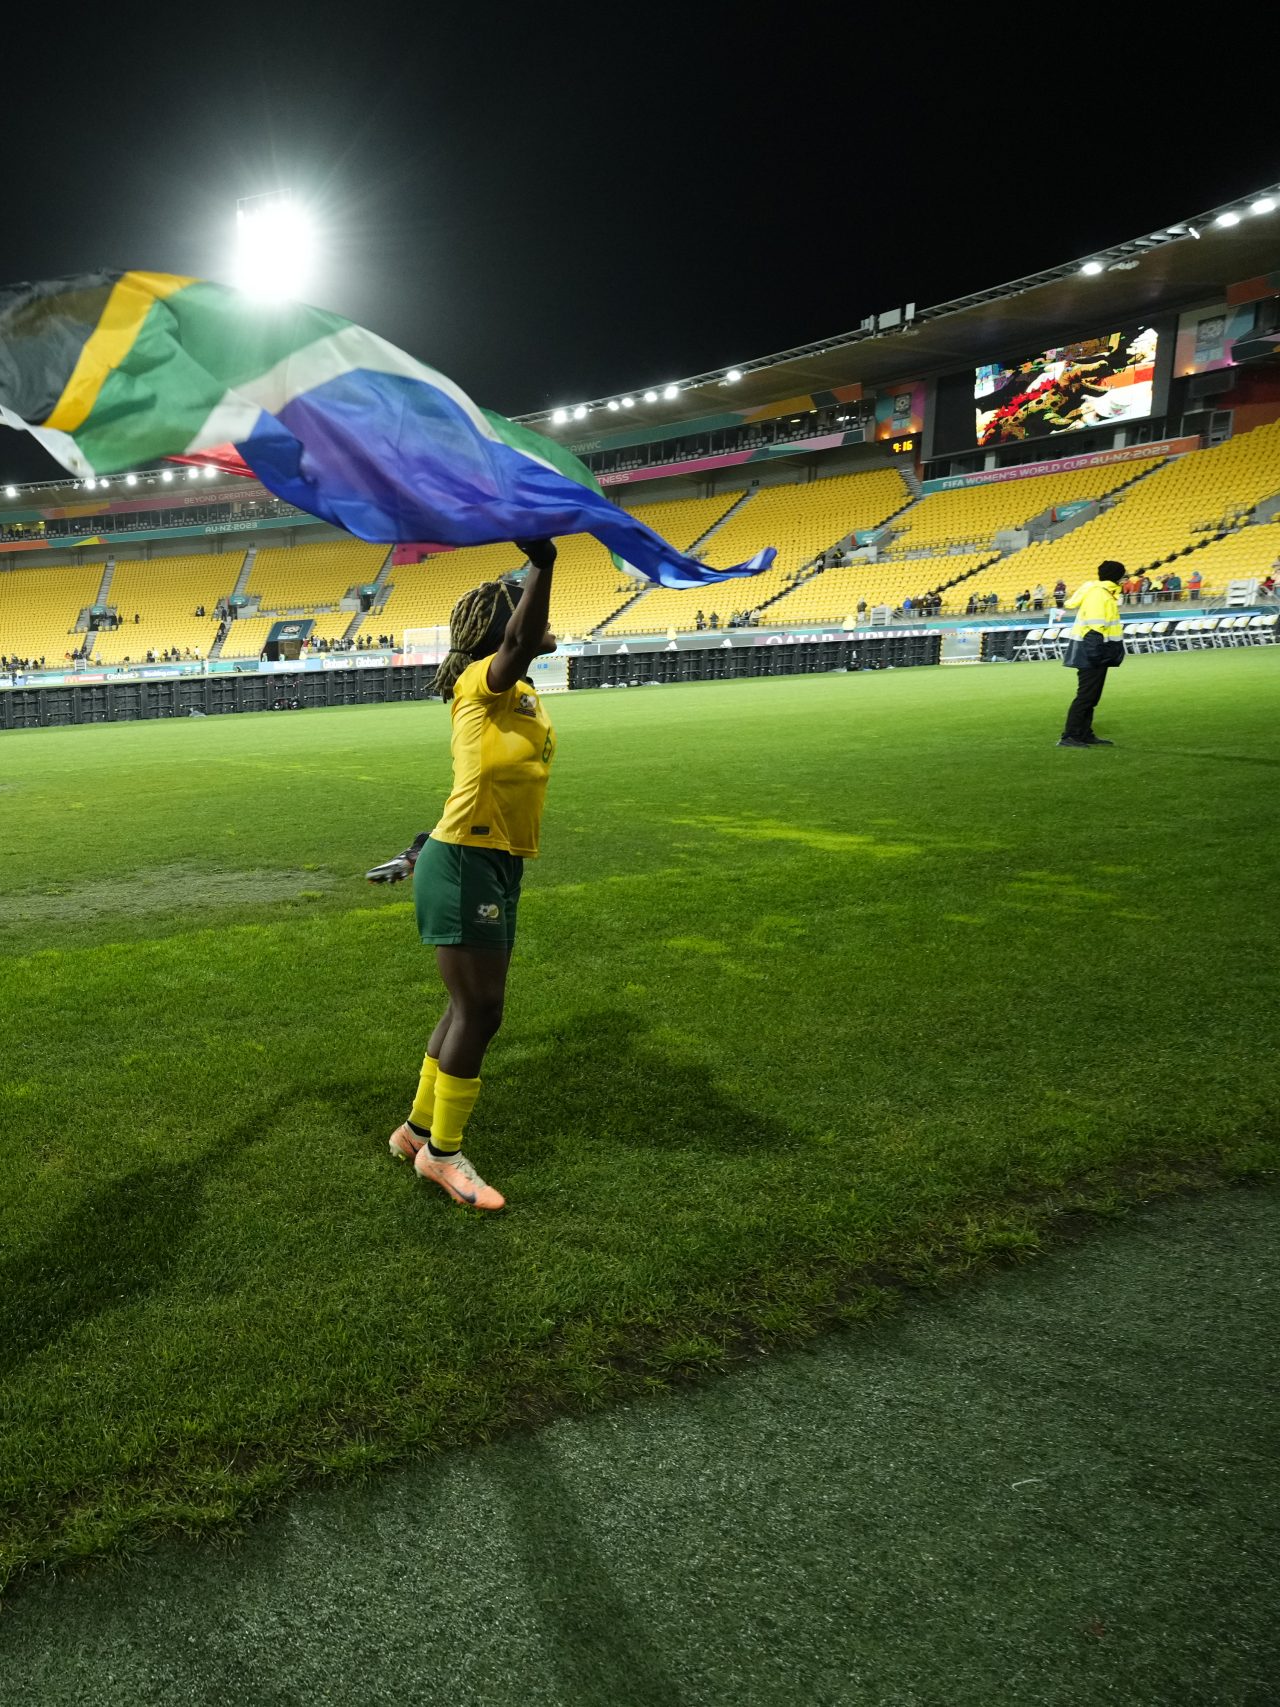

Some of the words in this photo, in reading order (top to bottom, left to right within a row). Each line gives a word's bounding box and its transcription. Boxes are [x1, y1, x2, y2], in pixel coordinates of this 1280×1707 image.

[570, 441, 601, 452] AWWC
[942, 479, 965, 488] FIFA
[966, 470, 1017, 485] WOMEN'S
[1020, 464, 1060, 477] WORLD
[1063, 458, 1088, 470] CUP
[597, 474, 630, 485] TNESS
[184, 494, 217, 504] BEYOND
[219, 490, 267, 500] GREATNESS
